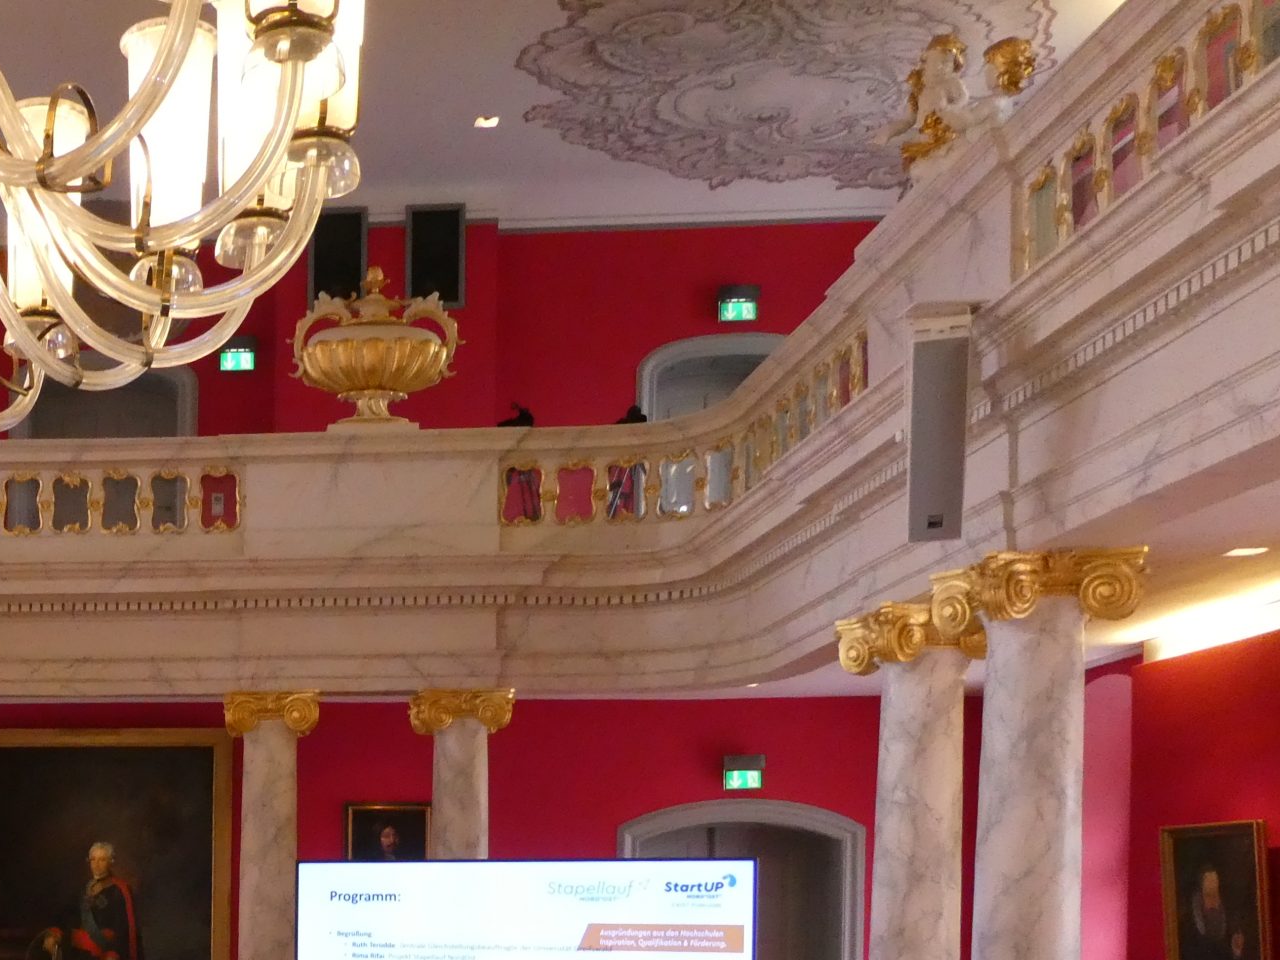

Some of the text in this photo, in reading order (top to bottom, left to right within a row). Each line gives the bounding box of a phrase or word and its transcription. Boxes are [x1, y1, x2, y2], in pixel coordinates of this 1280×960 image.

[548, 880, 634, 898] Stapellauf
[664, 881, 724, 893] StartUP
[330, 890, 401, 905] Programm:
[639, 938, 682, 949] Qualifikation
